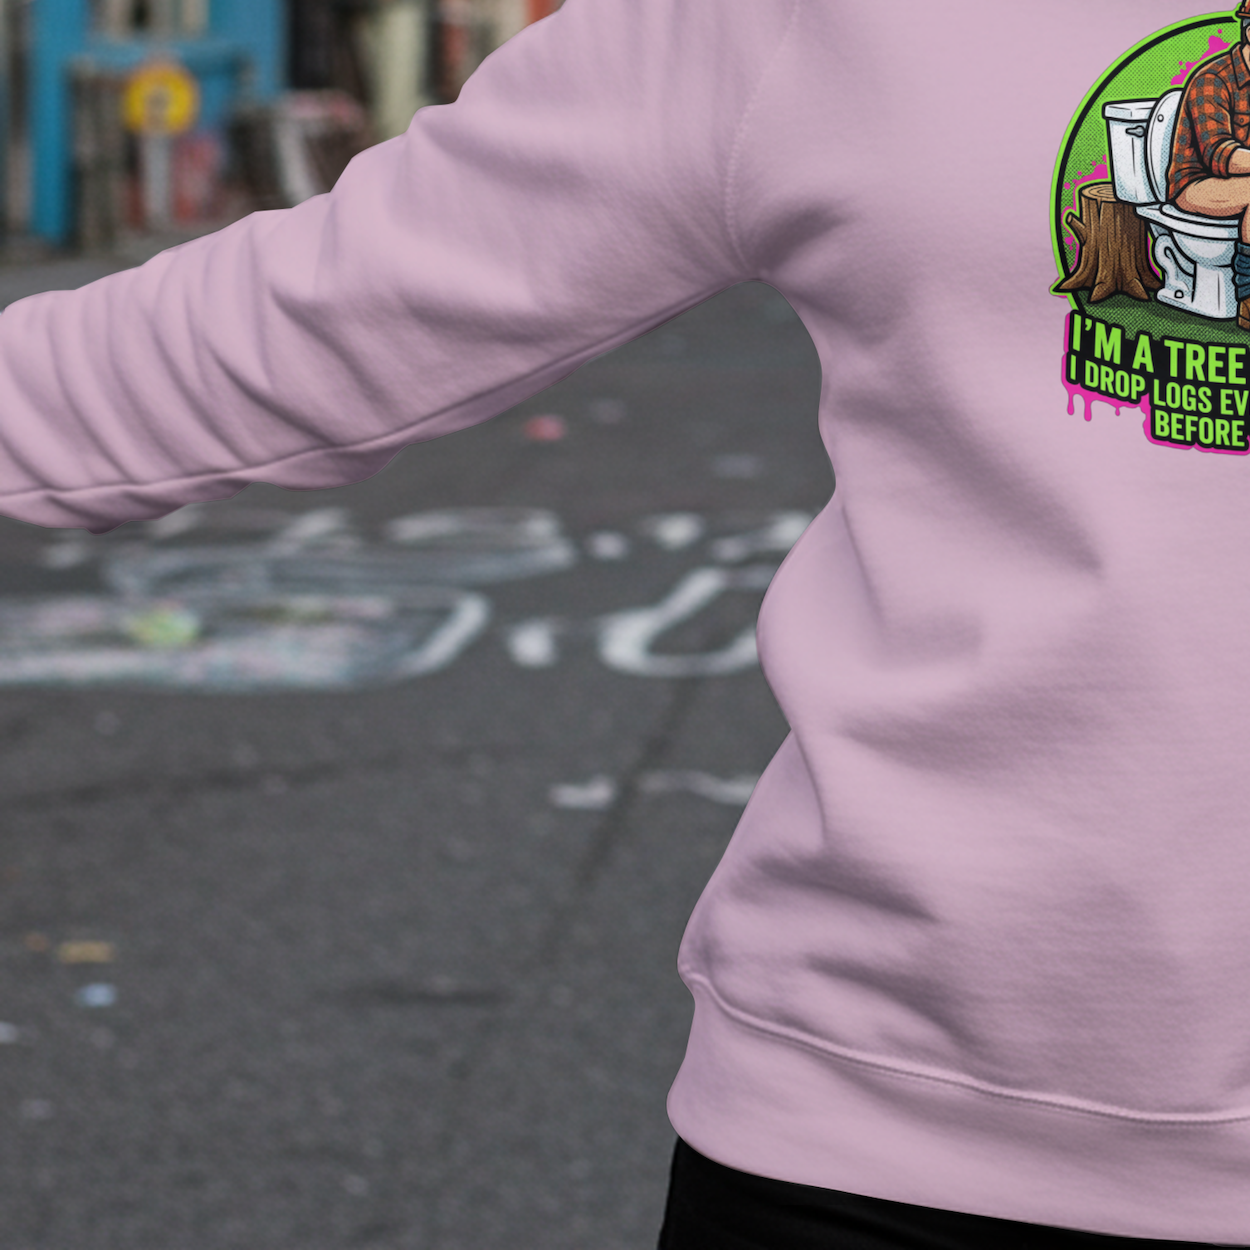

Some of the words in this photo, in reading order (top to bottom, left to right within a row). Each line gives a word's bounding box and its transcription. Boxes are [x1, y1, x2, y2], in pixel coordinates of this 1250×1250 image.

[1072, 314, 1122, 365] I'M
[1132, 334, 1155, 373] A
[1163, 339, 1247, 385] TREE
[1070, 354, 1077, 380] I
[1085, 360, 1146, 400] DROP
[1153, 378, 1212, 413] LOGS
[1155, 409, 1246, 447] BEFORE
